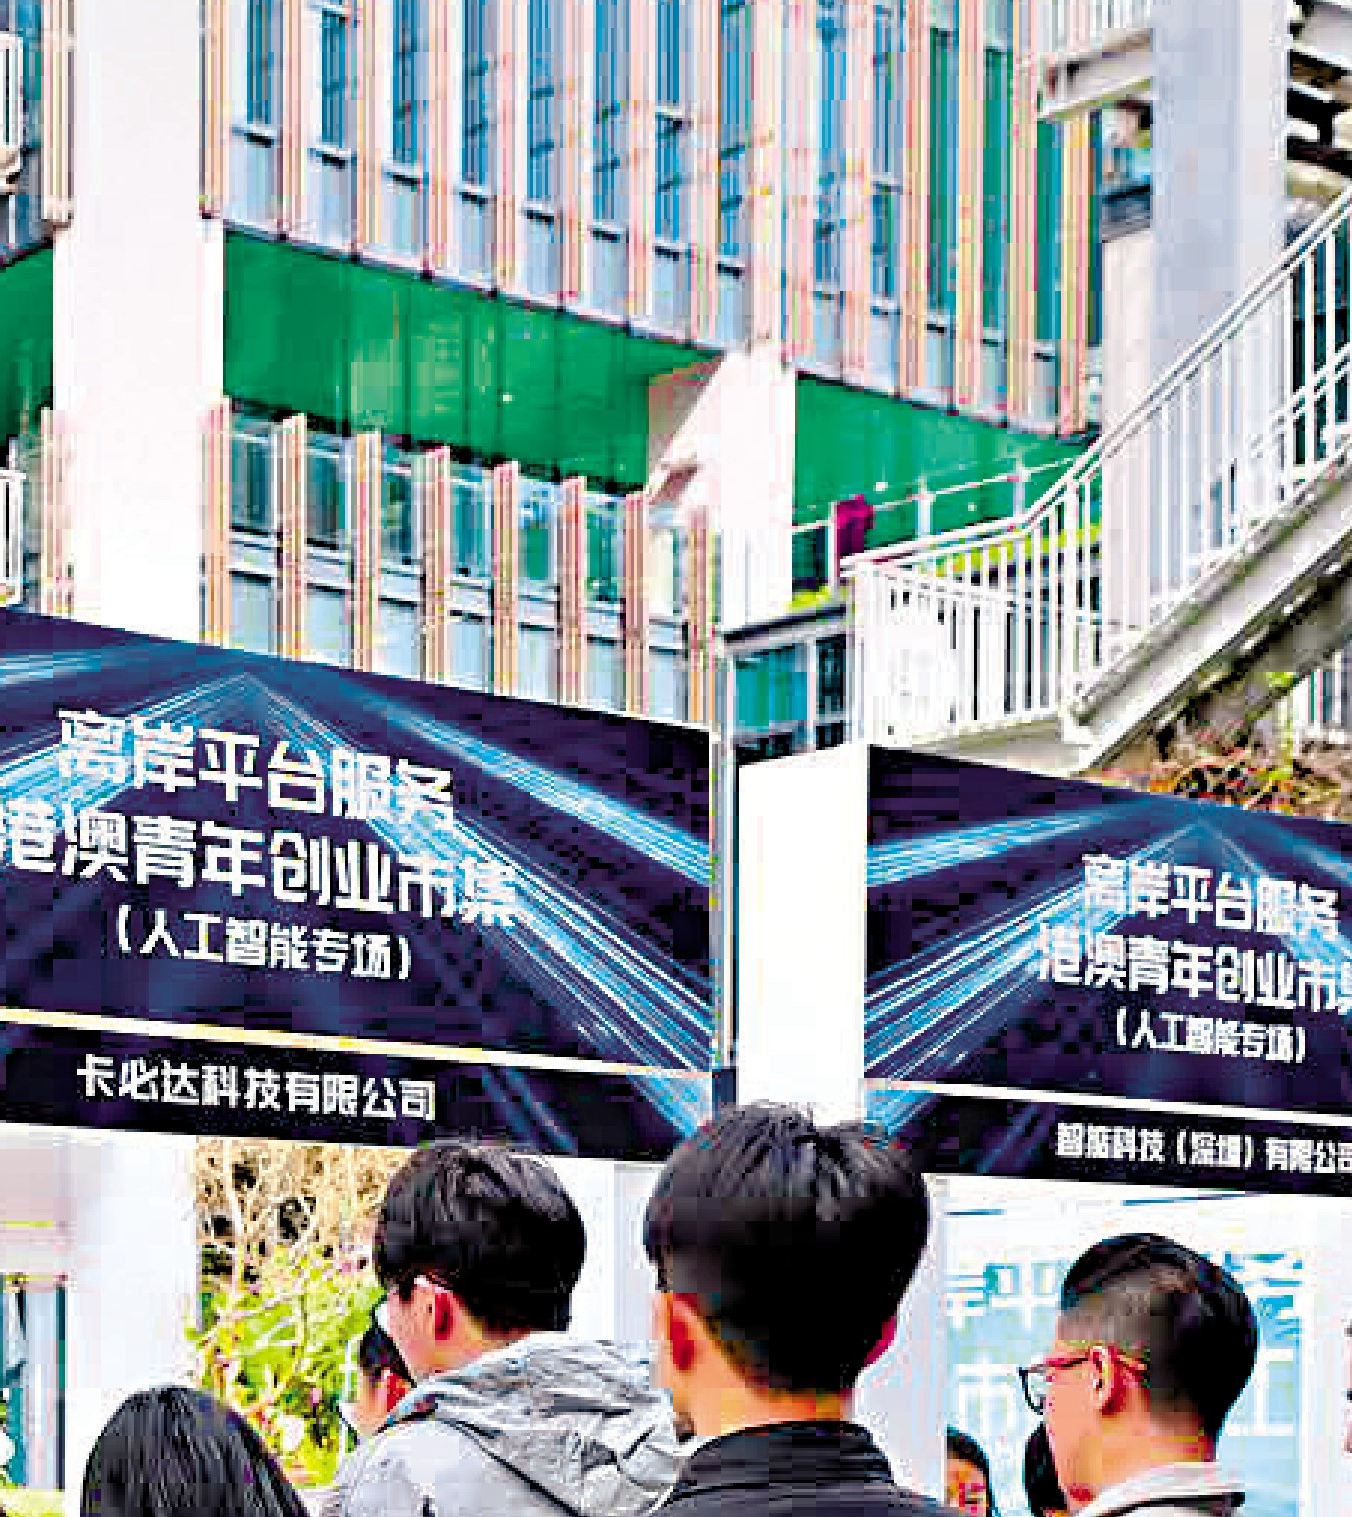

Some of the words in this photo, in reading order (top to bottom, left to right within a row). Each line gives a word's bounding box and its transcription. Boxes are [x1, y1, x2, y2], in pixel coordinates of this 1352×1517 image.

[58, 708, 455, 830] 离岸平台服务
[1082, 853, 1339, 942] 离岸平台服务
[116, 904, 413, 981] （人工智能专场）
[76, 1053, 437, 1123] 卡必达科技有限公司
